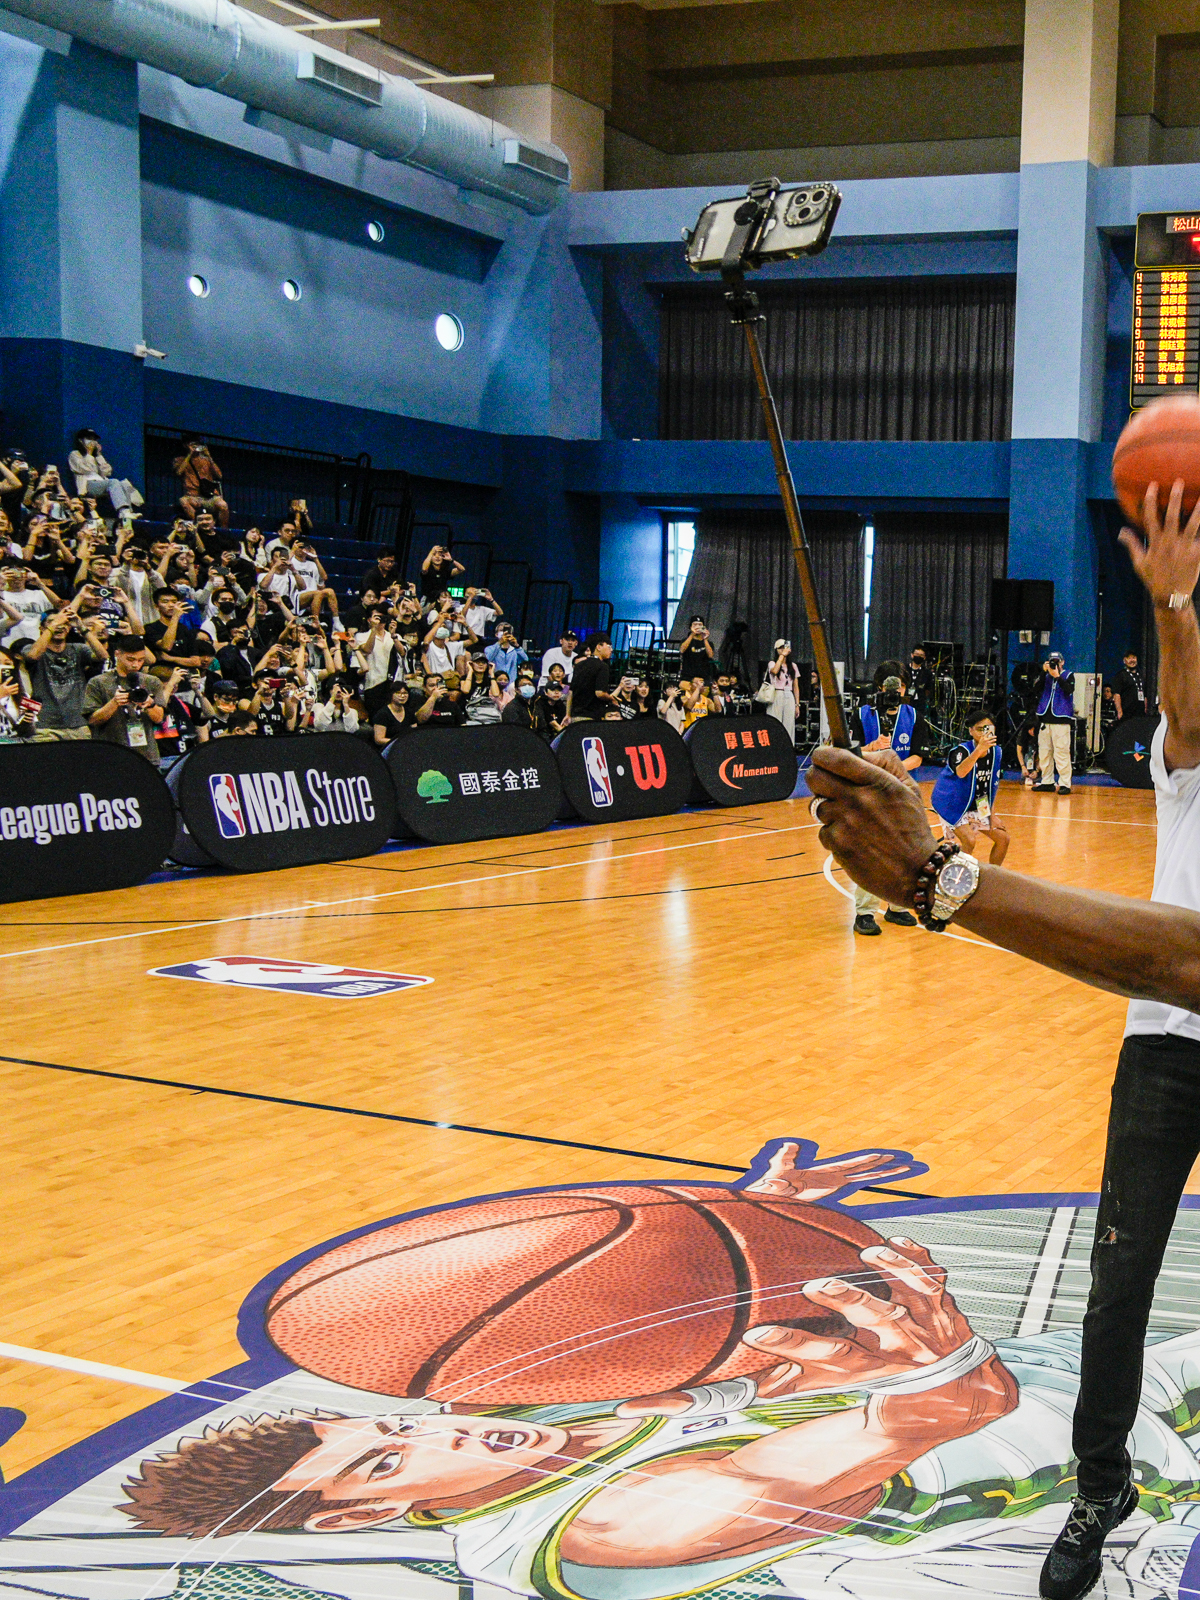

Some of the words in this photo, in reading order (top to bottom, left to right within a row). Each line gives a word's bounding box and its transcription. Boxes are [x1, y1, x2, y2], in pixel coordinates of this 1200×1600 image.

[1136, 272, 1143, 283] 4
[1136, 283, 1143, 294] 5
[1135, 295, 1142, 306] 6
[1135, 306, 1142, 317] 7
[1134, 317, 1142, 328] 8
[1134, 329, 1141, 339] 9
[1135, 340, 1145, 350] 10
[1134, 351, 1145, 362] 12
[1134, 362, 1145, 373] 13
[1134, 373, 1145, 384] 14
[723, 729, 771, 750] 摩曼頓
[732, 763, 779, 779] Momentum
[458, 766, 541, 796] 國泰金控
[238, 770, 311, 835] NBA
[306, 768, 376, 827] Store
[0, 802, 81, 845] eague
[79, 792, 143, 833] Pass
